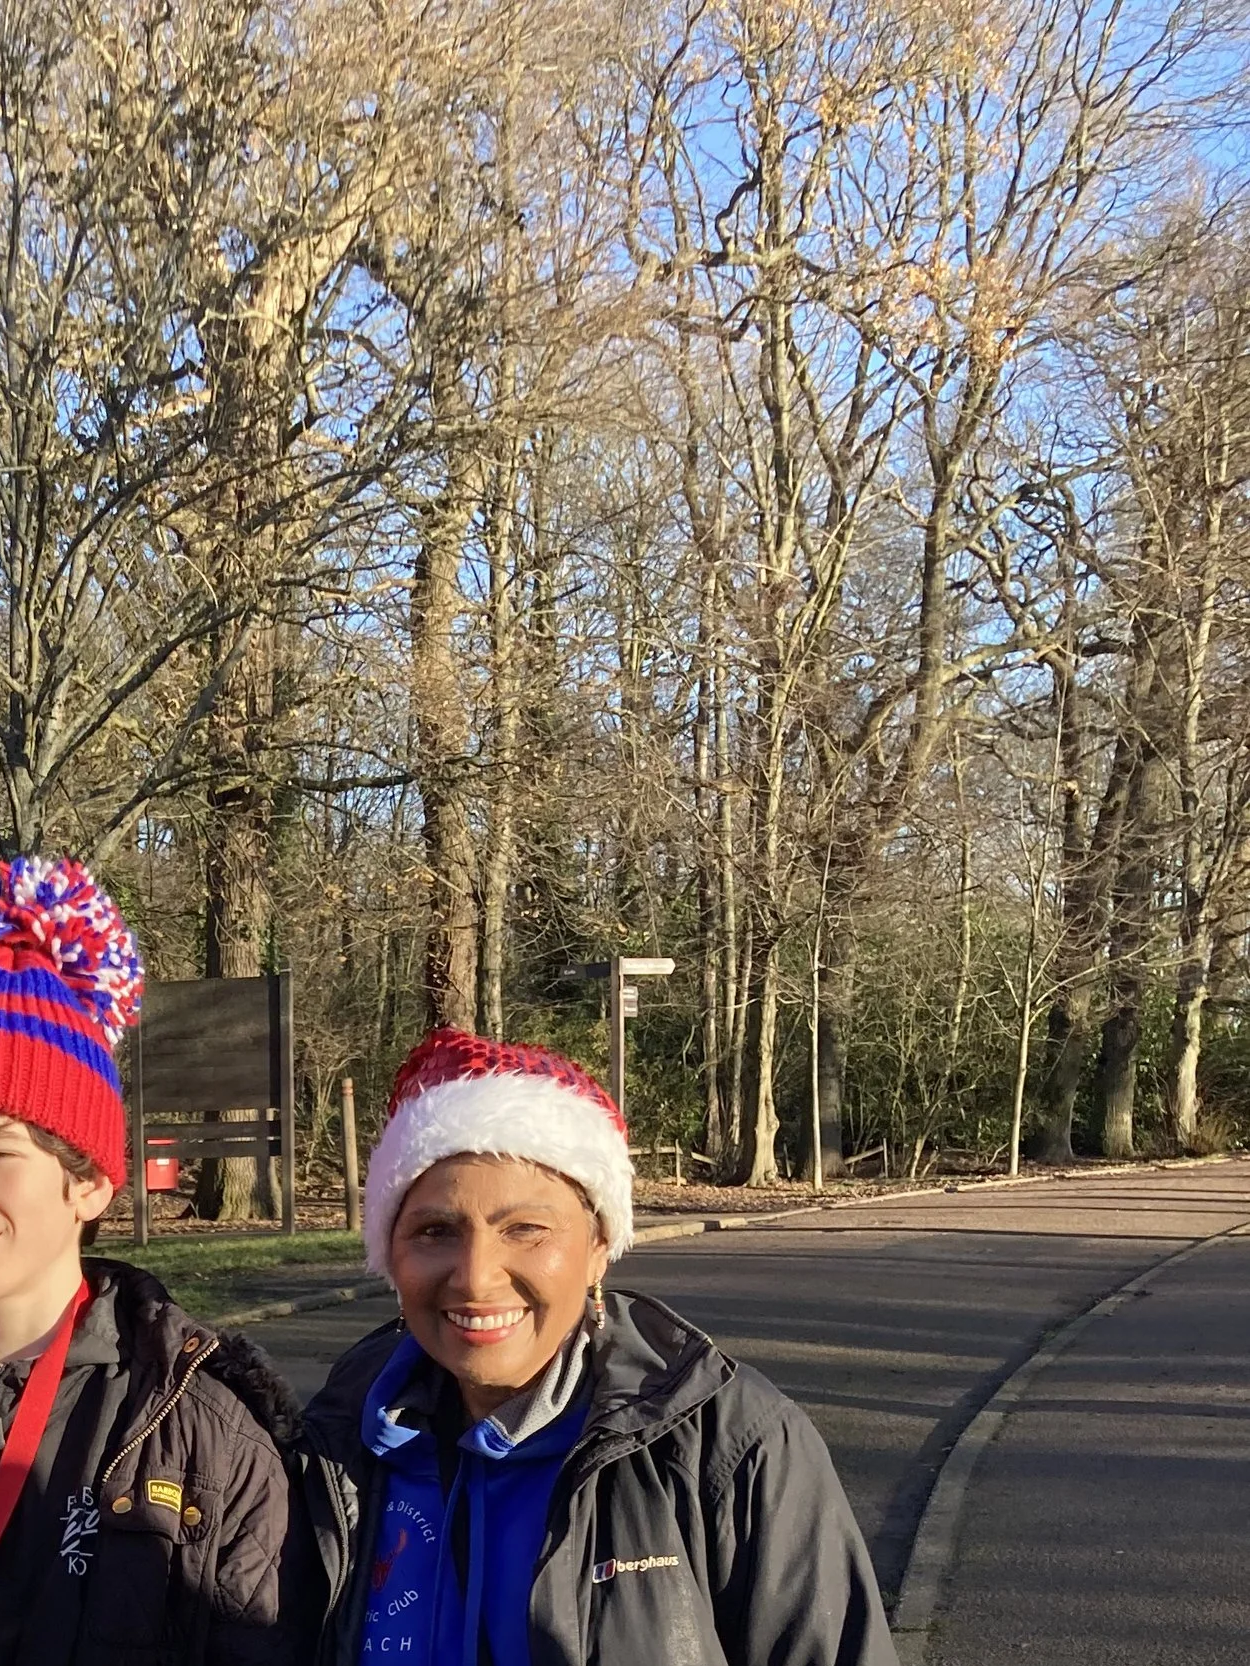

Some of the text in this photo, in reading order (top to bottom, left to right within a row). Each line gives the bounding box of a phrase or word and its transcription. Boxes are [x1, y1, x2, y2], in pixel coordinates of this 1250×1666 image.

[386, 1501, 436, 1544] & District
[616, 1555, 679, 1573] berghaus
[387, 1590, 419, 1616] Club
